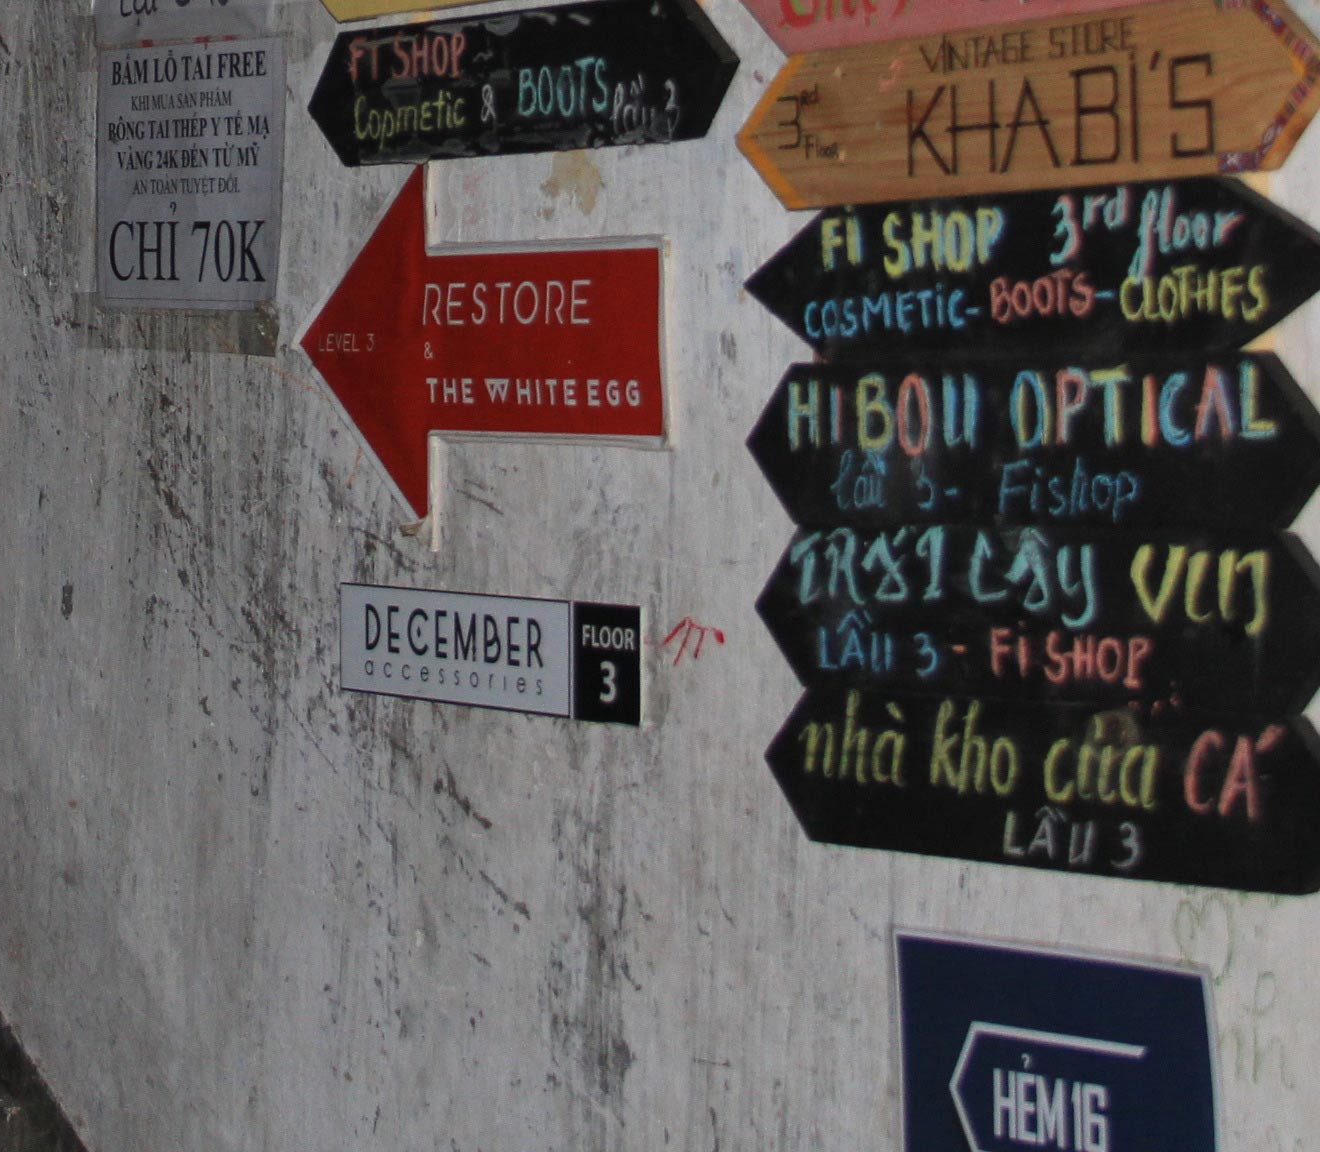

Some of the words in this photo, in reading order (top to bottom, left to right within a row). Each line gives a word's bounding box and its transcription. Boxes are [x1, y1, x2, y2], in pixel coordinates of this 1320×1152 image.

[182, 55, 211, 81] TAI
[218, 50, 267, 78] FREE
[392, 31, 467, 79] SHOP
[919, 30, 1036, 74] VINTAGE
[1048, 16, 1134, 58] STORE
[131, 95, 149, 112] KHI
[152, 94, 175, 110] MUA
[481, 84, 496, 122] &
[518, 57, 608, 117] BOOTS
[148, 120, 169, 139] TAI
[173, 113, 207, 138] THÉP
[211, 117, 221, 137] Y
[907, 48, 1215, 177] KHABI'S
[156, 150, 178, 169] 24K
[133, 179, 150, 196] AN
[109, 201, 179, 282] CHỈ
[192, 219, 266, 283] 70K
[882, 207, 1005, 279] SHOP
[1049, 185, 1131, 265] 3rd
[1127, 185, 1246, 285] floor
[422, 279, 591, 327] RESTORE
[1120, 264, 1271, 322] CLOTHES
[318, 333, 360, 353] LEVEL
[366, 333, 375, 351] 3
[423, 341, 434, 360] &
[426, 377, 475, 405] THE
[484, 377, 577, 406] WHITE
[587, 379, 641, 407] EGG
[1009, 360, 1279, 450] OPTICAL
[364, 602, 544, 669] DECEMBER
[582, 624, 635, 651] FLOOR
[364, 659, 543, 696] accessories
[599, 661, 617, 703] 3
[913, 632, 938, 677] 3
[1043, 632, 1153, 688] SHOP
[798, 689, 905, 786] nhà
[930, 699, 1018, 795] kho
[1110, 822, 1142, 869] 3
[1071, 1081, 1109, 1152] 16
